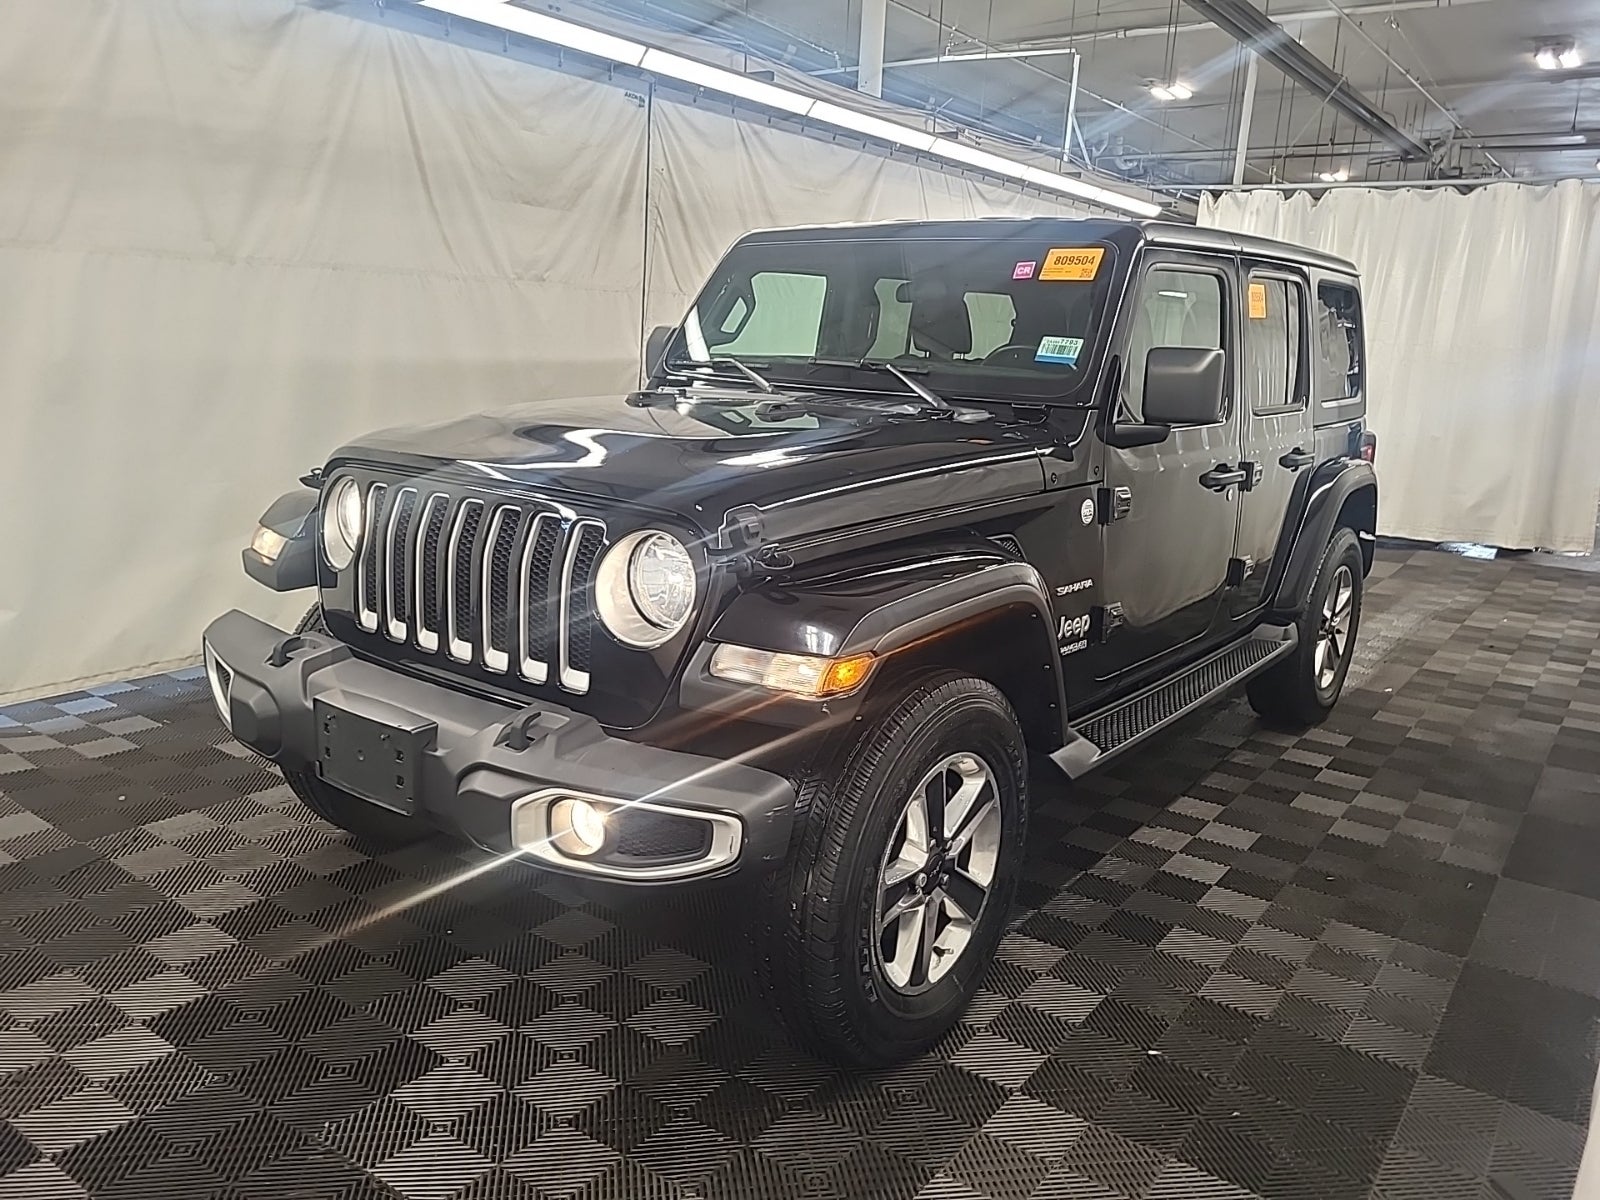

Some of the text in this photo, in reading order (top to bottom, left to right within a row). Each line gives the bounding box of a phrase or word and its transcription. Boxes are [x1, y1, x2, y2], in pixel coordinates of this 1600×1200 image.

[1053, 255, 1096, 266] 809504
[1017, 266, 1031, 275] CR
[1055, 579, 1093, 596] SAHARA
[1057, 614, 1091, 640] Jeep
